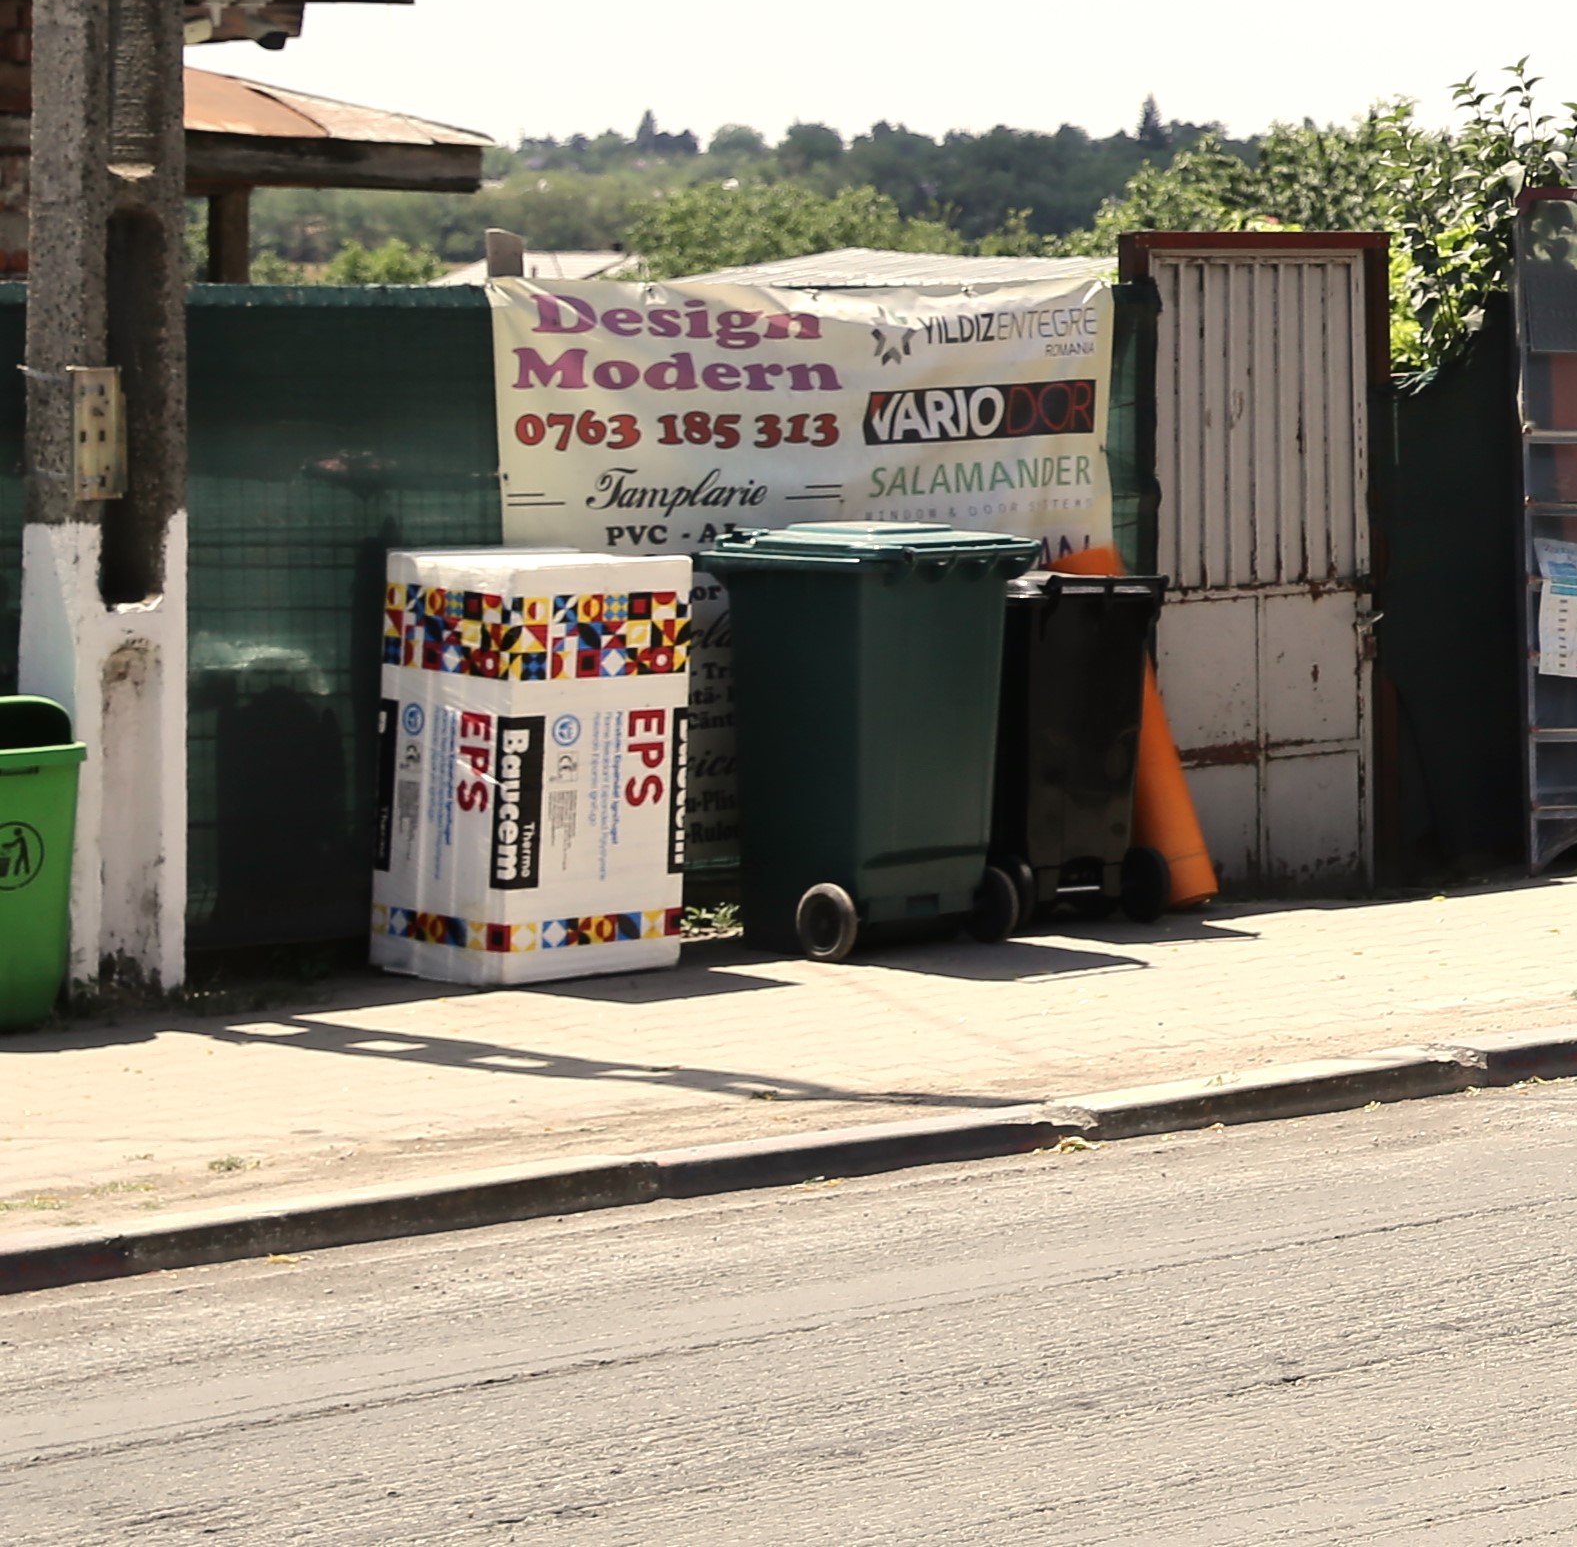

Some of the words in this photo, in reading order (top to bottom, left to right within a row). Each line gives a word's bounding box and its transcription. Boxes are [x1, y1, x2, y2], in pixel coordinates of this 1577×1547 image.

[531, 293, 823, 350] Design
[512, 346, 843, 393] Modern
[1045, 343, 1095, 357] ROMANIA
[514, 409, 641, 451] 0763
[657, 411, 741, 450] 185
[753, 411, 840, 449] 313
[585, 466, 768, 517] Tamplarie
[868, 455, 1092, 499] SALAMANDER
[968, 501, 1018, 517] DOOR
[605, 524, 668, 547] PVC
[457, 711, 493, 813] EPS
[624, 708, 666, 808] EPS
[495, 728, 530, 881] Baucem
[520, 821, 536, 878] Thermo
